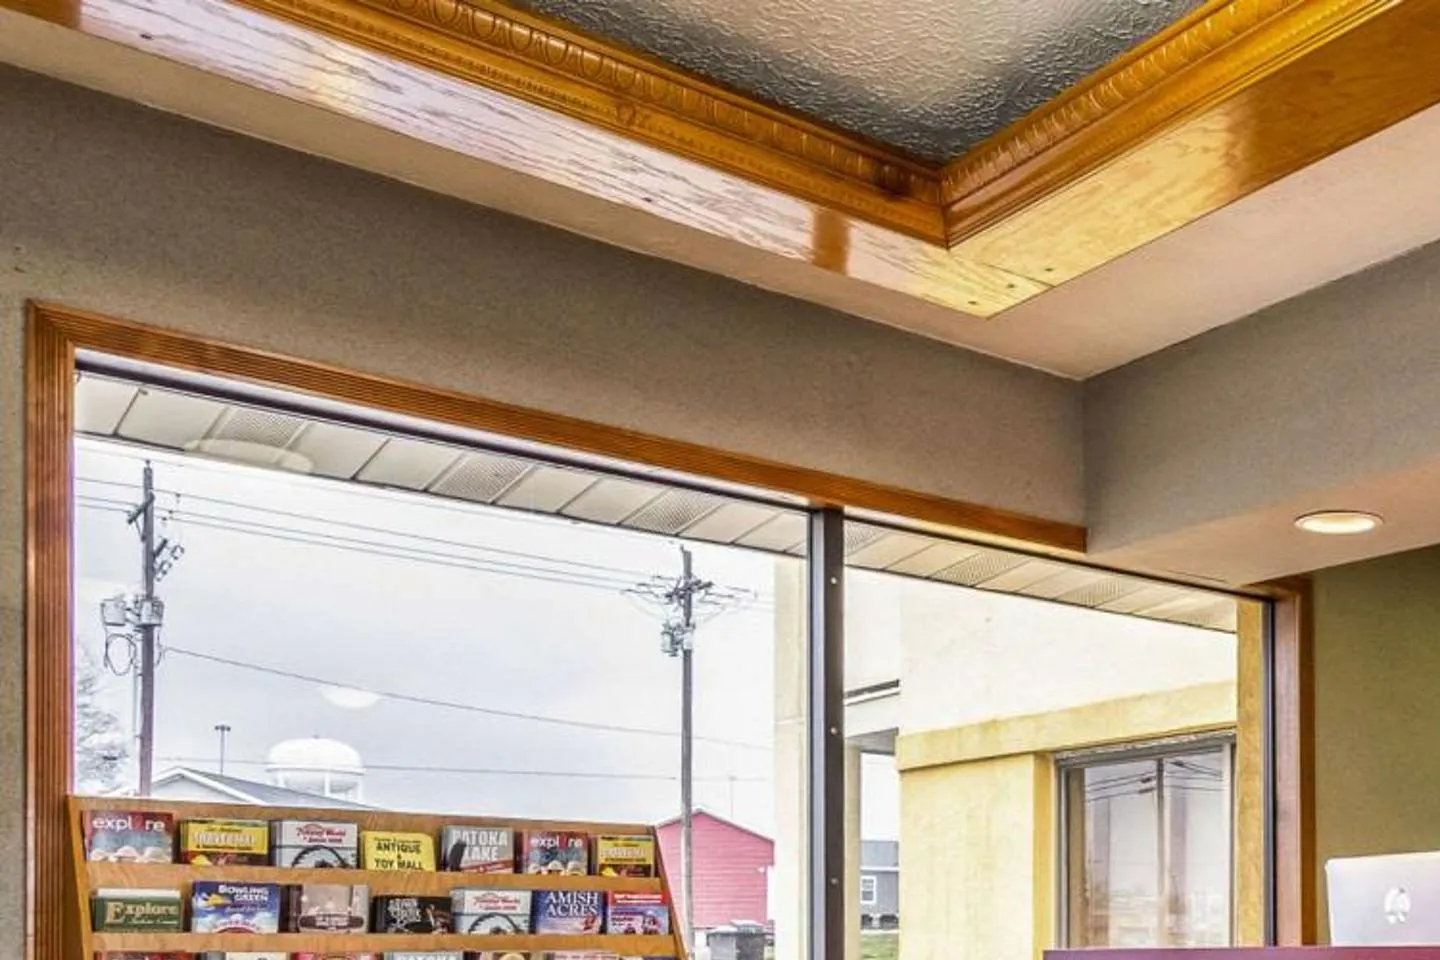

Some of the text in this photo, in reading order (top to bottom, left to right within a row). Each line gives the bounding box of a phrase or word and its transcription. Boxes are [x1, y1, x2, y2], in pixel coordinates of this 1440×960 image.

[452, 831, 508, 847] PATOKA
[376, 842, 421, 854] ANTIQUE
[548, 891, 599, 905] AMISH
[547, 903, 598, 917] ACRES
